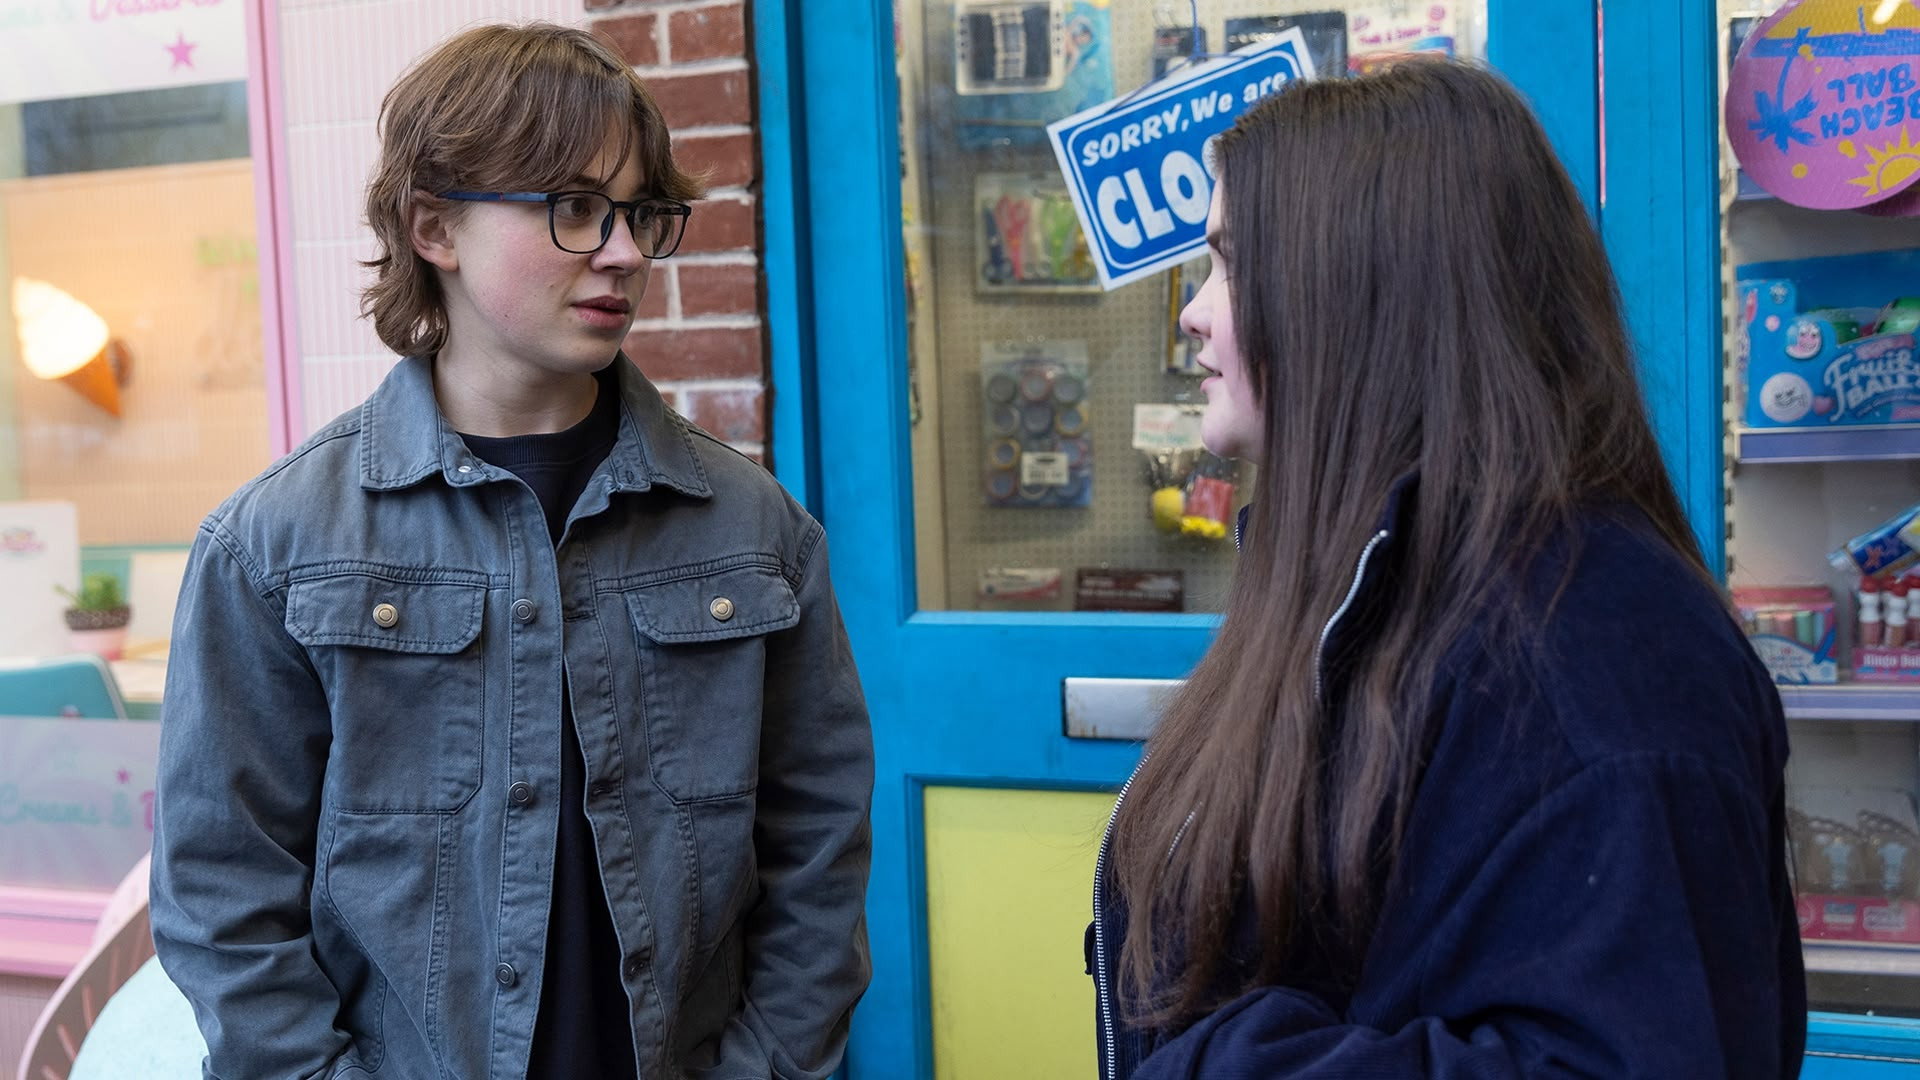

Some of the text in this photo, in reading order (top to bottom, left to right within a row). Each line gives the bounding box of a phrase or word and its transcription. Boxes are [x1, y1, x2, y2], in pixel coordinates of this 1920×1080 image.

[1827, 62, 1916, 103] BALL
[1082, 71, 1288, 167] SORRY, We are
[1823, 348, 1914, 422] Fruit
[1846, 369, 1920, 409] BALL
